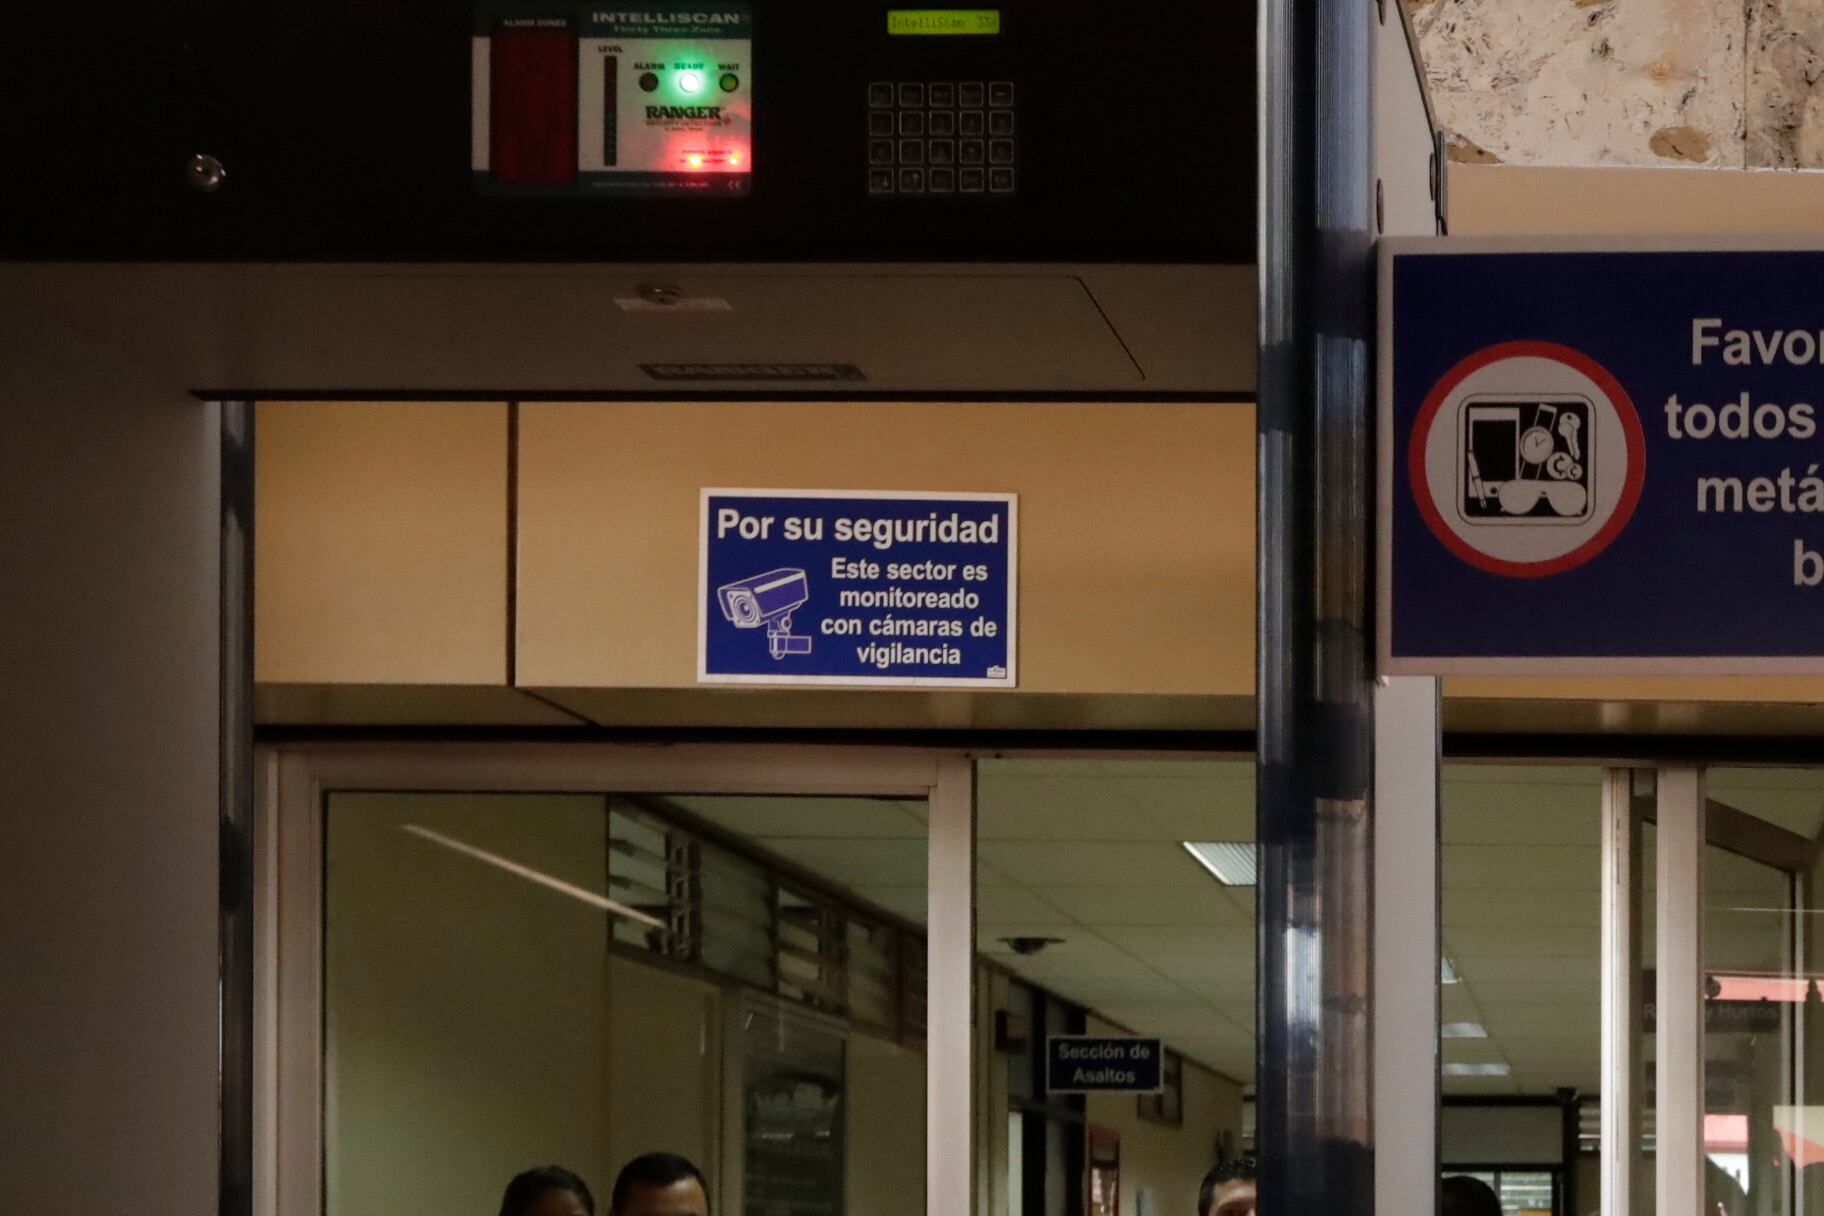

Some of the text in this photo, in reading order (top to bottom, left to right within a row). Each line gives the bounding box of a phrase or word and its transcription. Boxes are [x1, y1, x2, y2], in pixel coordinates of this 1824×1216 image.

[593, 12, 740, 24] INTELLISCAN
[598, 45, 623, 53] LEVEL
[634, 62, 665, 70] ALARM
[718, 62, 740, 70] WAIT
[645, 106, 722, 120] RANGER
[1664, 391, 1817, 439] todos
[717, 508, 999, 550] Por su seguridad
[831, 556, 989, 581] Este sector es
[839, 586, 980, 609] monitoreado
[820, 613, 998, 637] con cámaras de
[856, 641, 961, 669] vigilancia
[1058, 1042, 1150, 1060] Sección de
[1073, 1067, 1136, 1084] Asaltos
